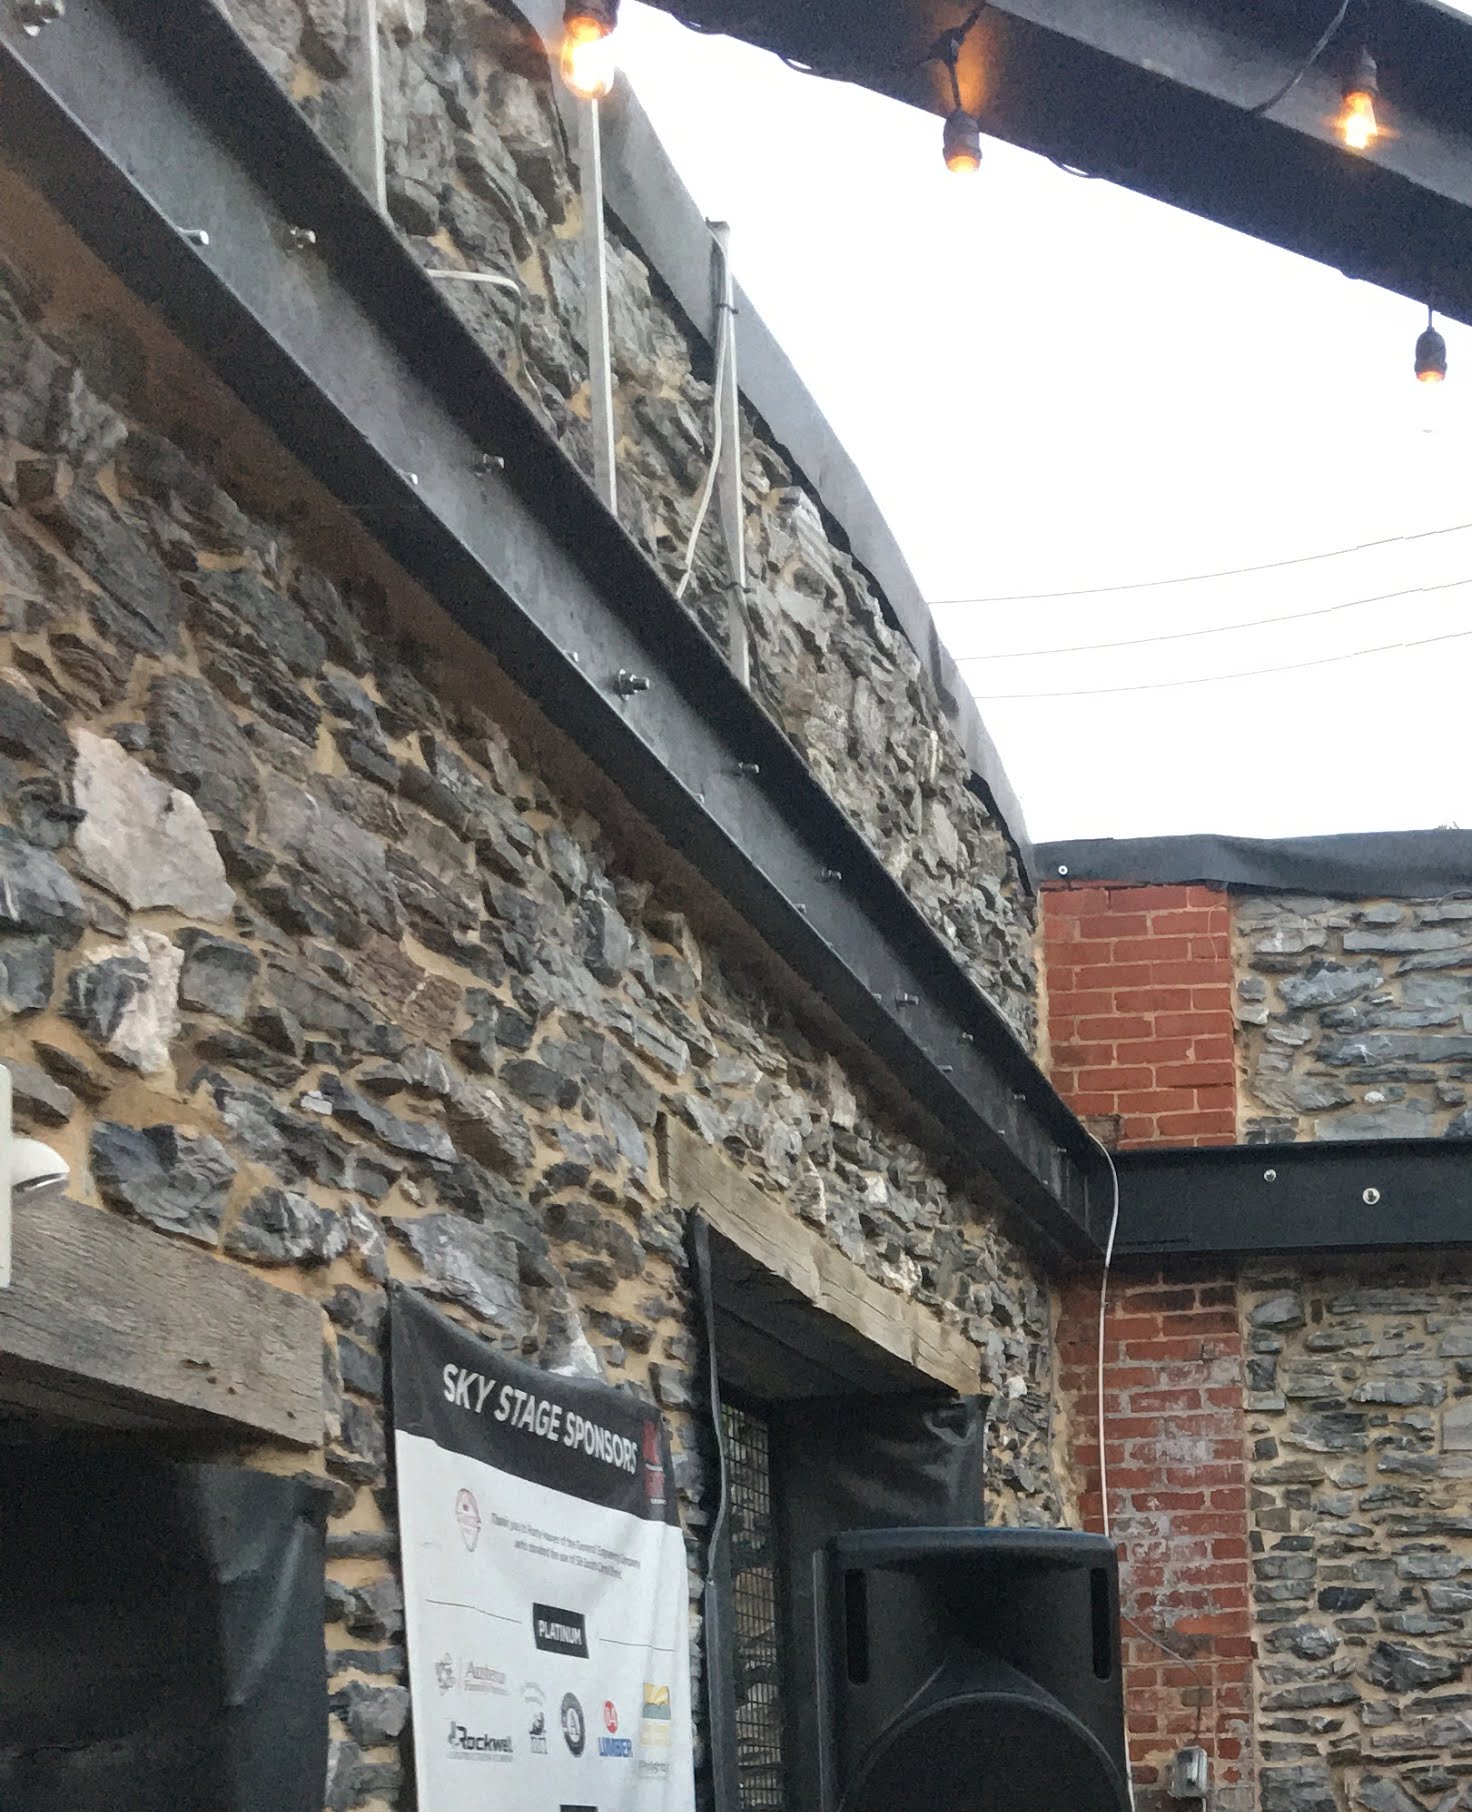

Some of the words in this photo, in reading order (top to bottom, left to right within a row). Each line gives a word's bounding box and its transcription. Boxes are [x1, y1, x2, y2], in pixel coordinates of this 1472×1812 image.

[443, 1364, 497, 1413] SKY
[494, 1385, 562, 1442] STAGE
[563, 1411, 638, 1475] SPONSORS
[538, 1619, 583, 1646] PLATINUM
